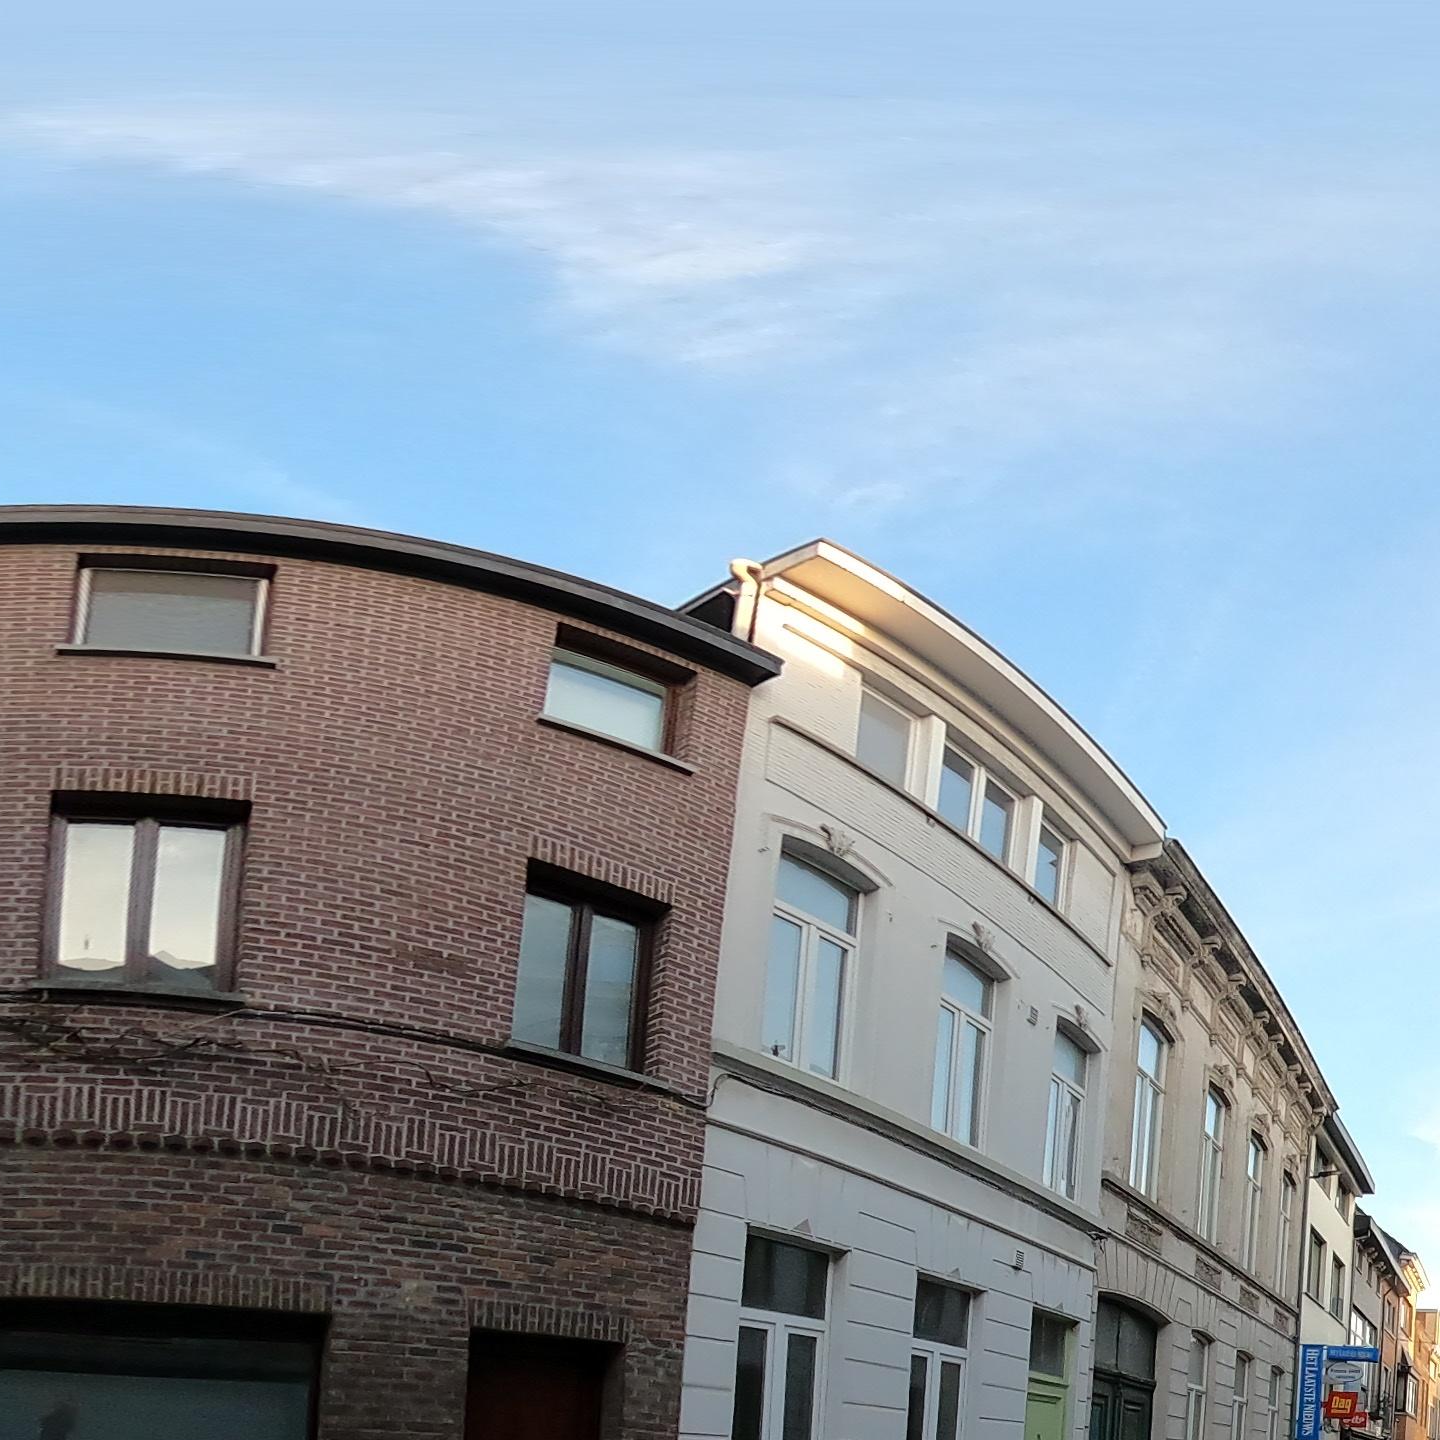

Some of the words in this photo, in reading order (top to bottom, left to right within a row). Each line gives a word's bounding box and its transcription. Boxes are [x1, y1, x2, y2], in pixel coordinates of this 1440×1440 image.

[1305, 1349, 1319, 1366] HET
[1303, 1367, 1318, 1403] LAATSTE
[1331, 1396, 1352, 1413] Dag
[1302, 1403, 1315, 1436] NIEUWS
